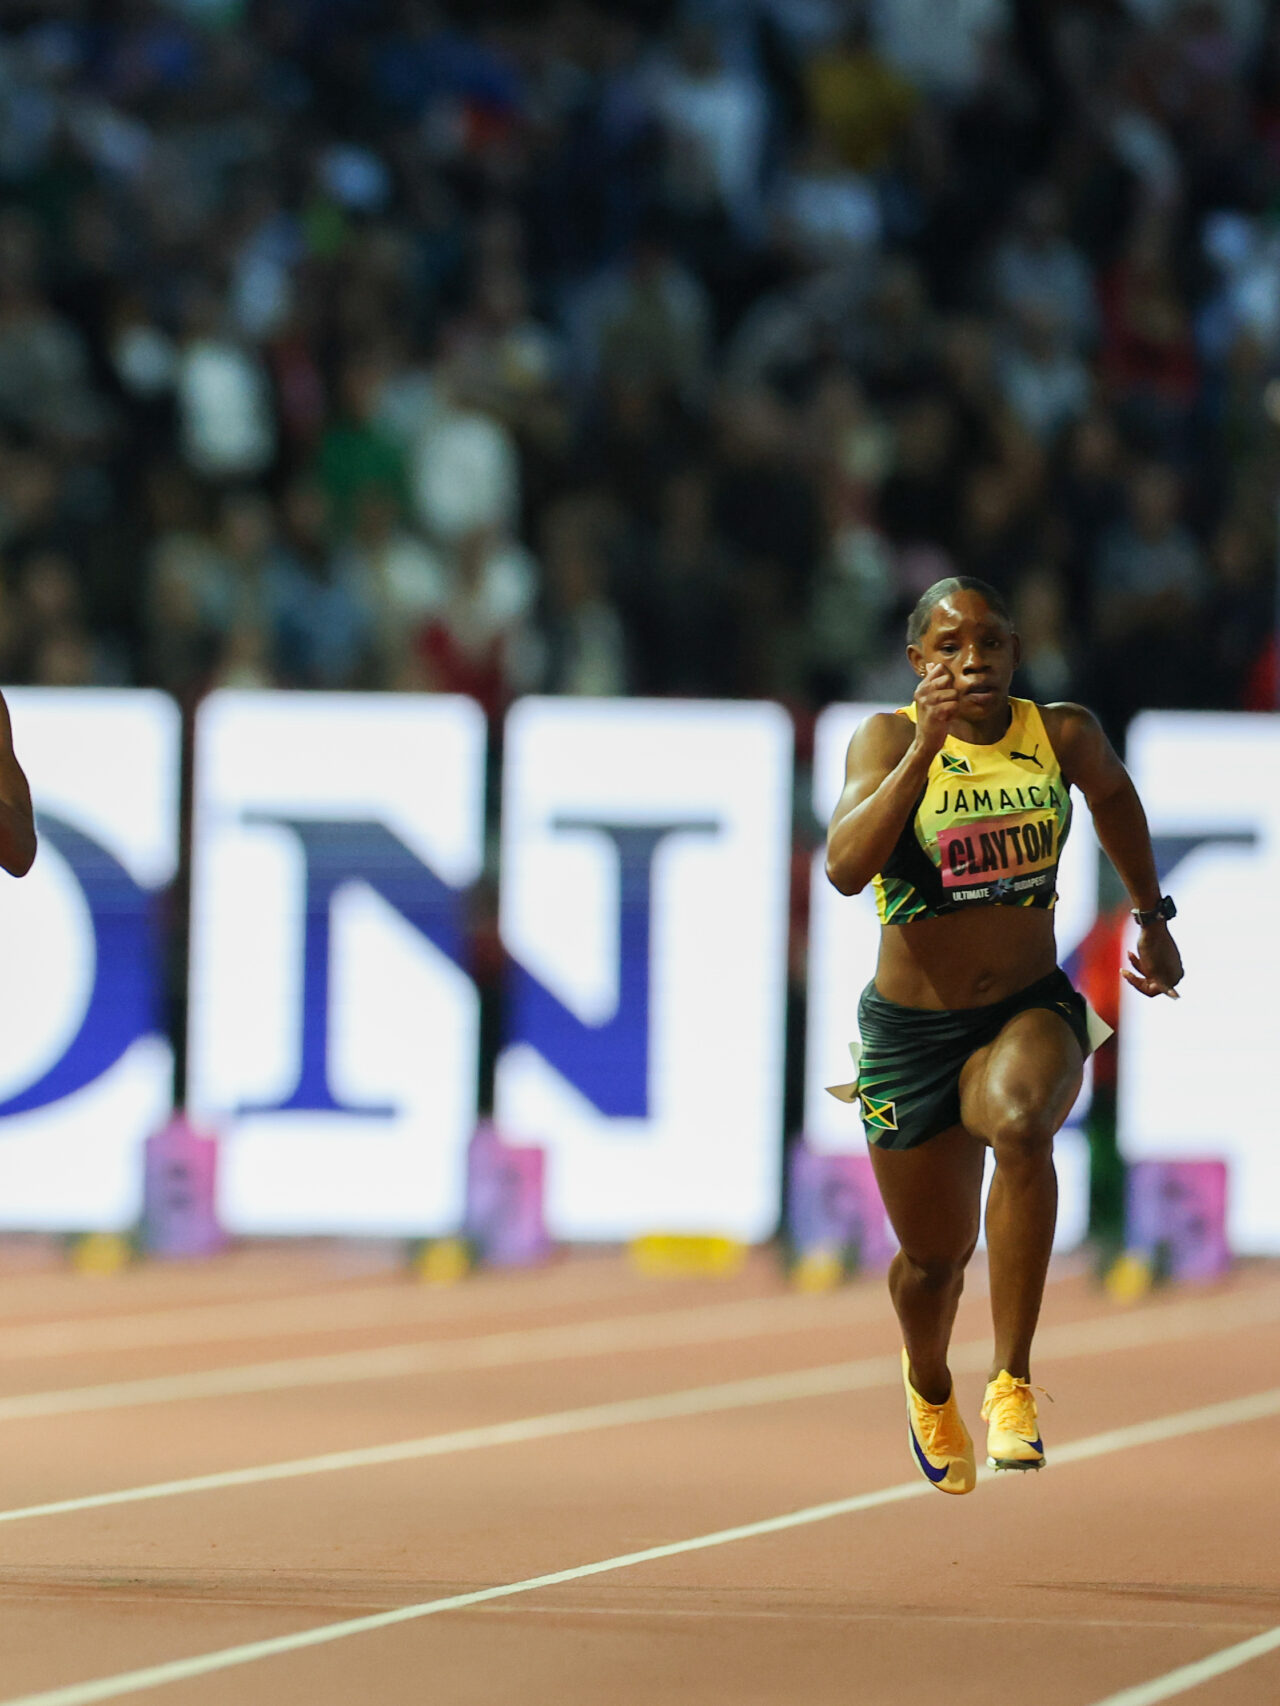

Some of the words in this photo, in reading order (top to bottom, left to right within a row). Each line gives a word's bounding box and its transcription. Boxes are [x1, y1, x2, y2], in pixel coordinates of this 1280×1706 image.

[935, 785, 1062, 815] JAMAICA
[948, 818, 1054, 876] CLAYTON
[952, 888, 990, 901] ULTIMATE
